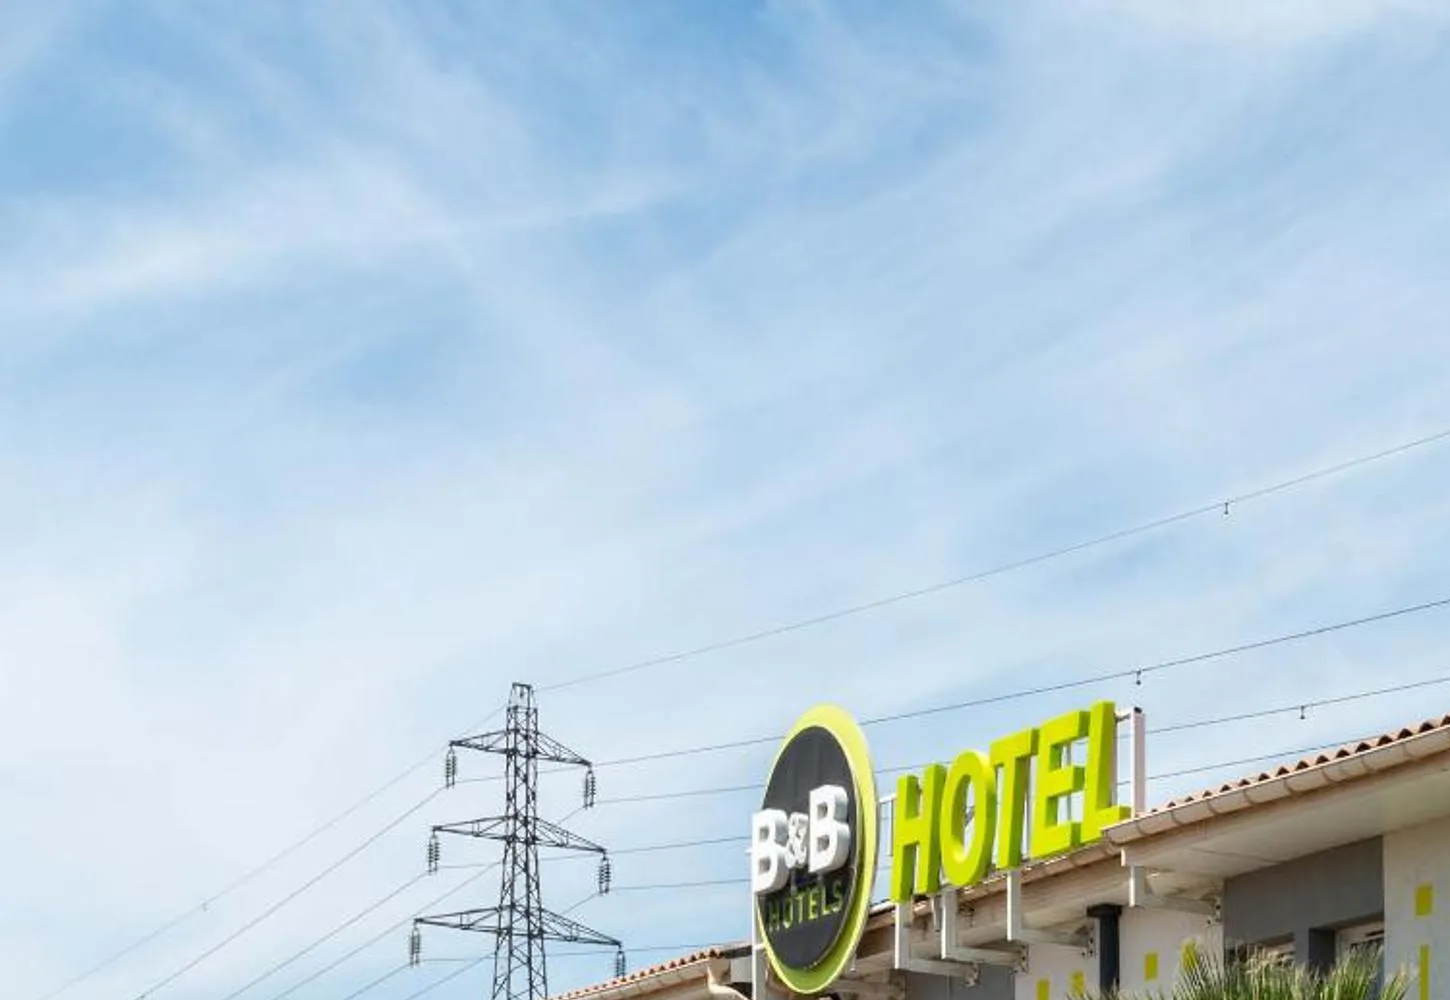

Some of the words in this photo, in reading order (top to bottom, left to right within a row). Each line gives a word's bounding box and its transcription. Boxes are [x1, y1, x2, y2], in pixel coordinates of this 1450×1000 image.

[752, 784, 850, 893] B&B
[891, 700, 1130, 902] HOTEL
[768, 880, 844, 932] HOTELS
